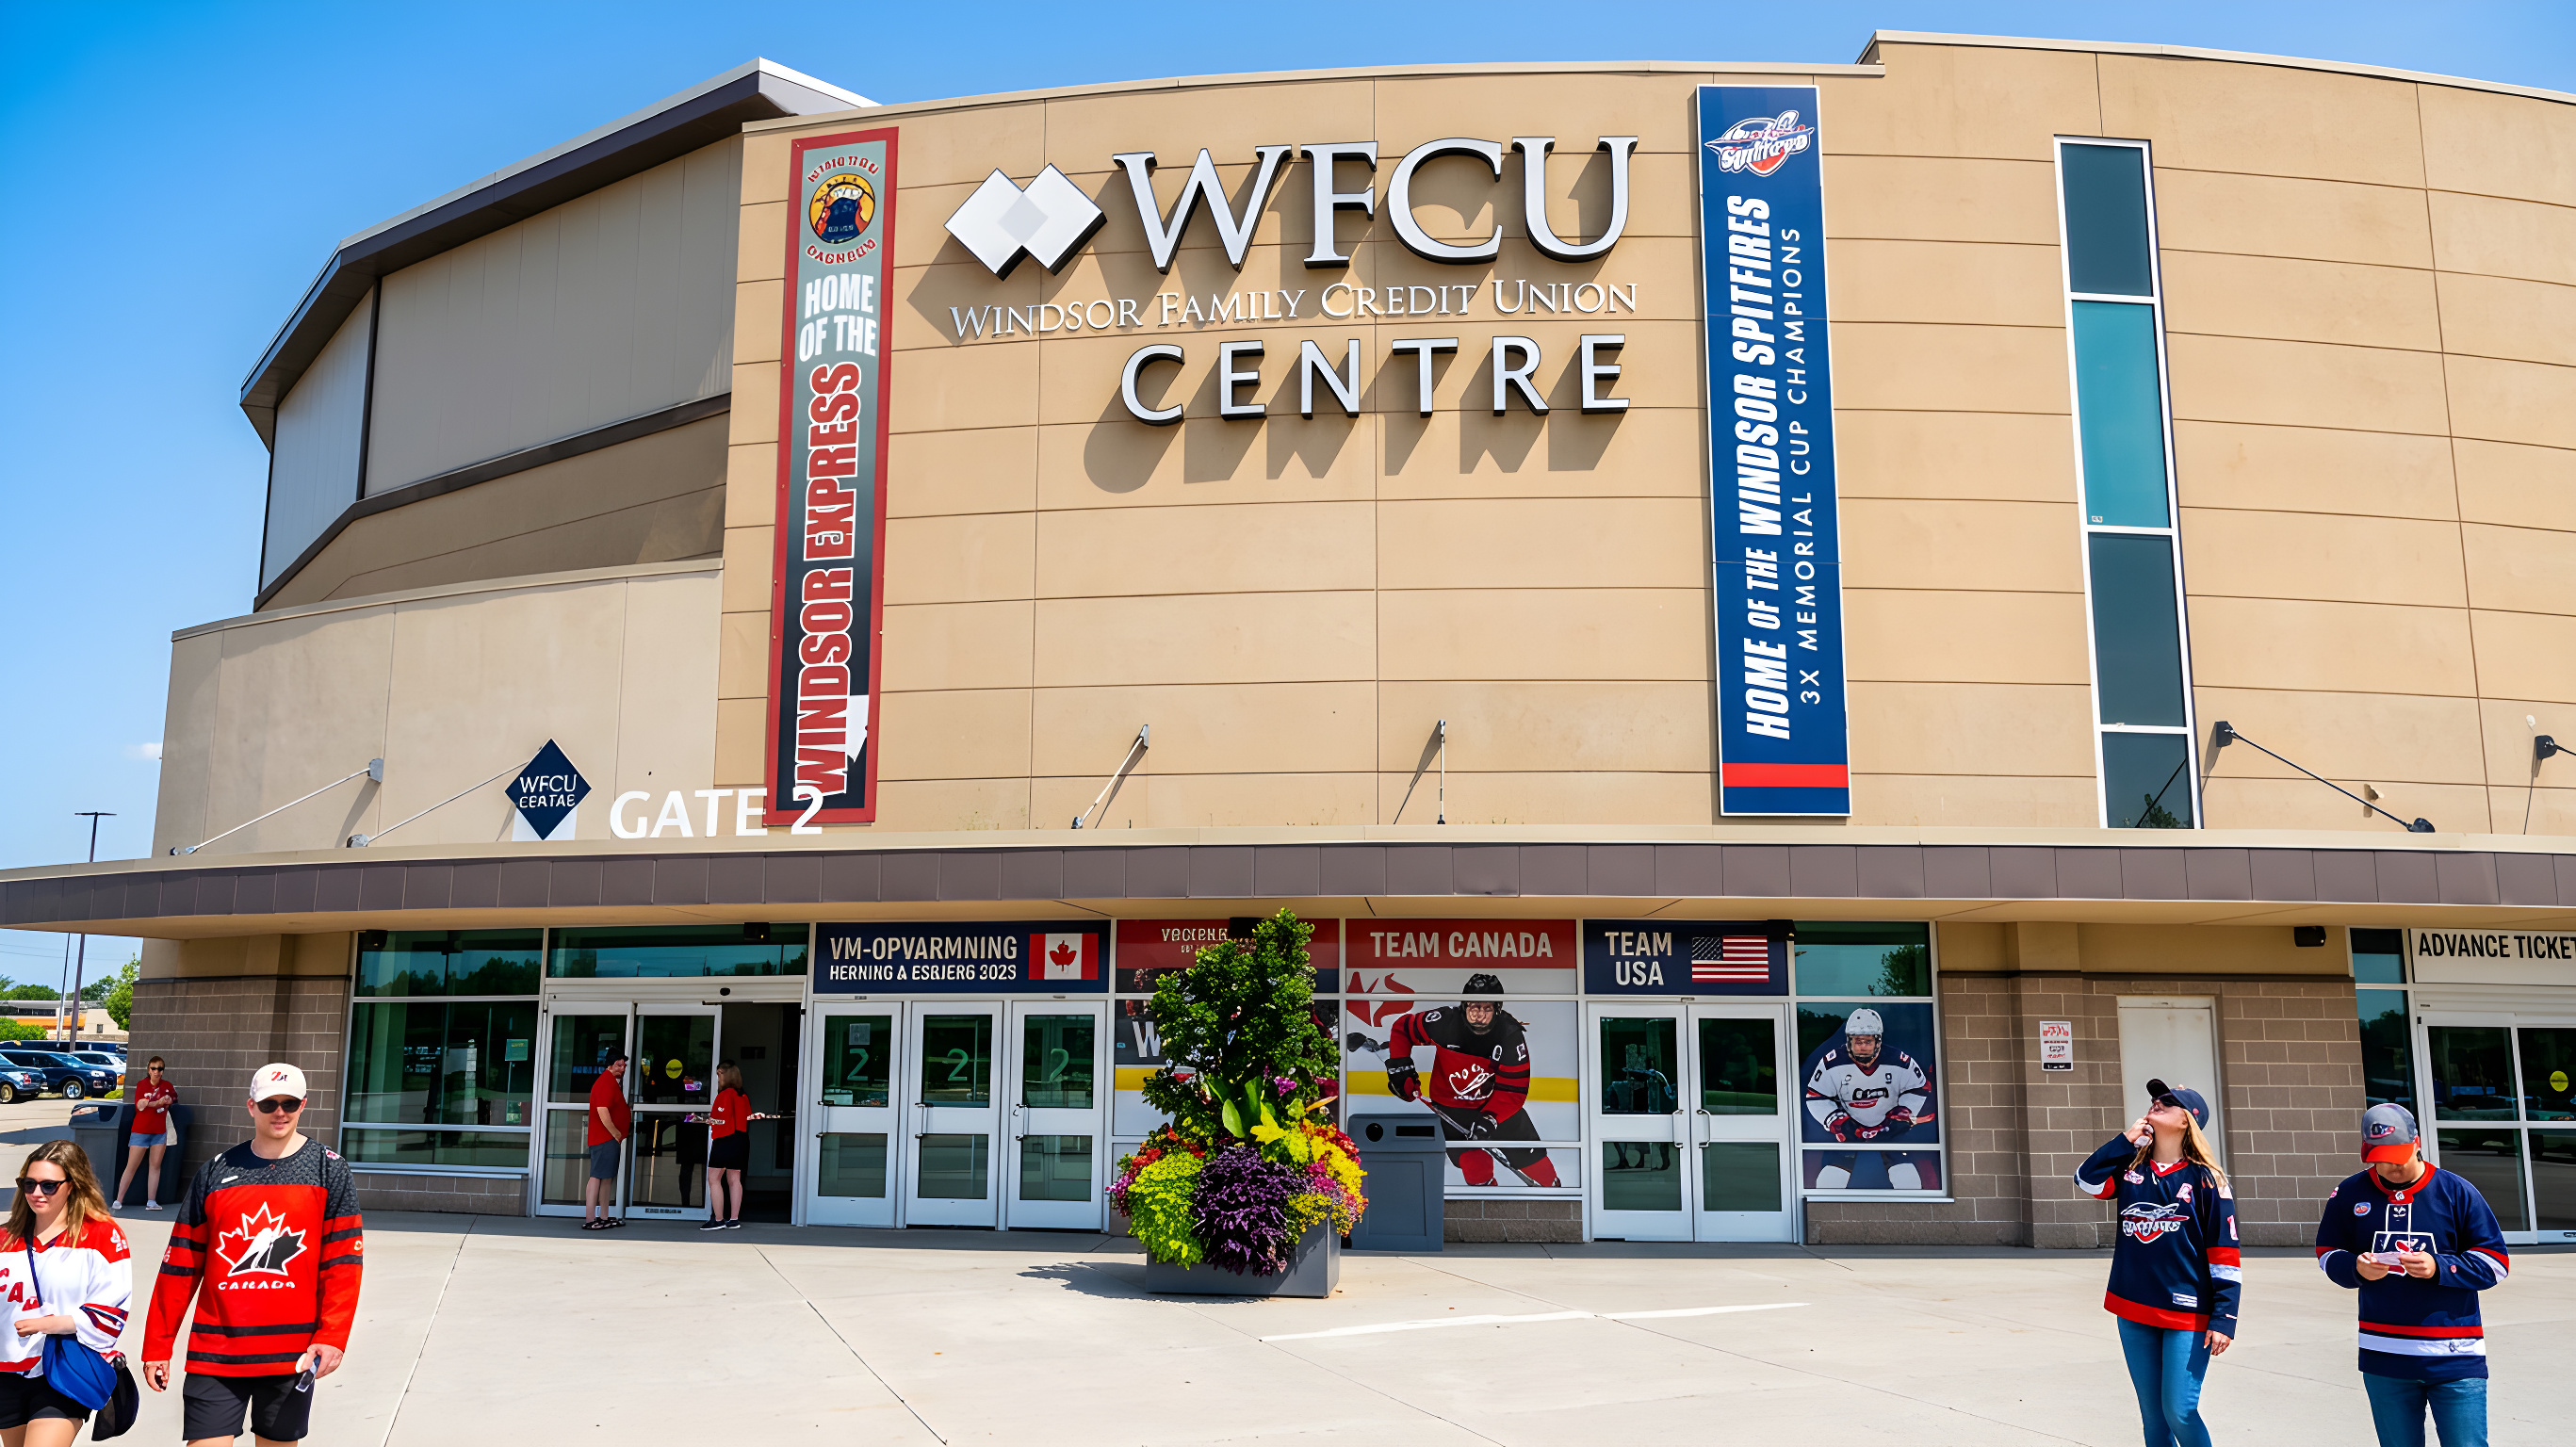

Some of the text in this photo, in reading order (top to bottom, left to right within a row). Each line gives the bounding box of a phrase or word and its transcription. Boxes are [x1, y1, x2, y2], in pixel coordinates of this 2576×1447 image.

[1112, 136, 1639, 275] WFCU
[805, 273, 874, 319] HOME
[1727, 195, 1776, 366] SPITFIRES
[950, 279, 1638, 339] WINDSOR FAMILY CREDIT UNION
[799, 315, 877, 362] OF THE
[1121, 334, 1630, 425] CENTRE
[1734, 373, 1783, 536] WINDSOR
[1782, 228, 1821, 705] 3X MEMORIAL CUP CHAMPIONS
[793, 361, 861, 801] WINDSOR EXPRESS
[1745, 546, 1780, 591] THE
[1747, 597, 1782, 630] OF
[1744, 638, 1790, 740] HOME
[519, 773, 577, 793] WFCU
[610, 785, 823, 838] GATE 2
[830, 935, 1018, 960] VM-OPVARMNING
[1370, 931, 1554, 958] TEAM CANADA
[1605, 932, 1672, 957] TEAM
[2419, 932, 2510, 958] ADVANCE
[829, 964, 893, 981] HERNING
[1615, 960, 1665, 986] USA
[847, 1048, 870, 1081] 2
[947, 1048, 969, 1081] 2
